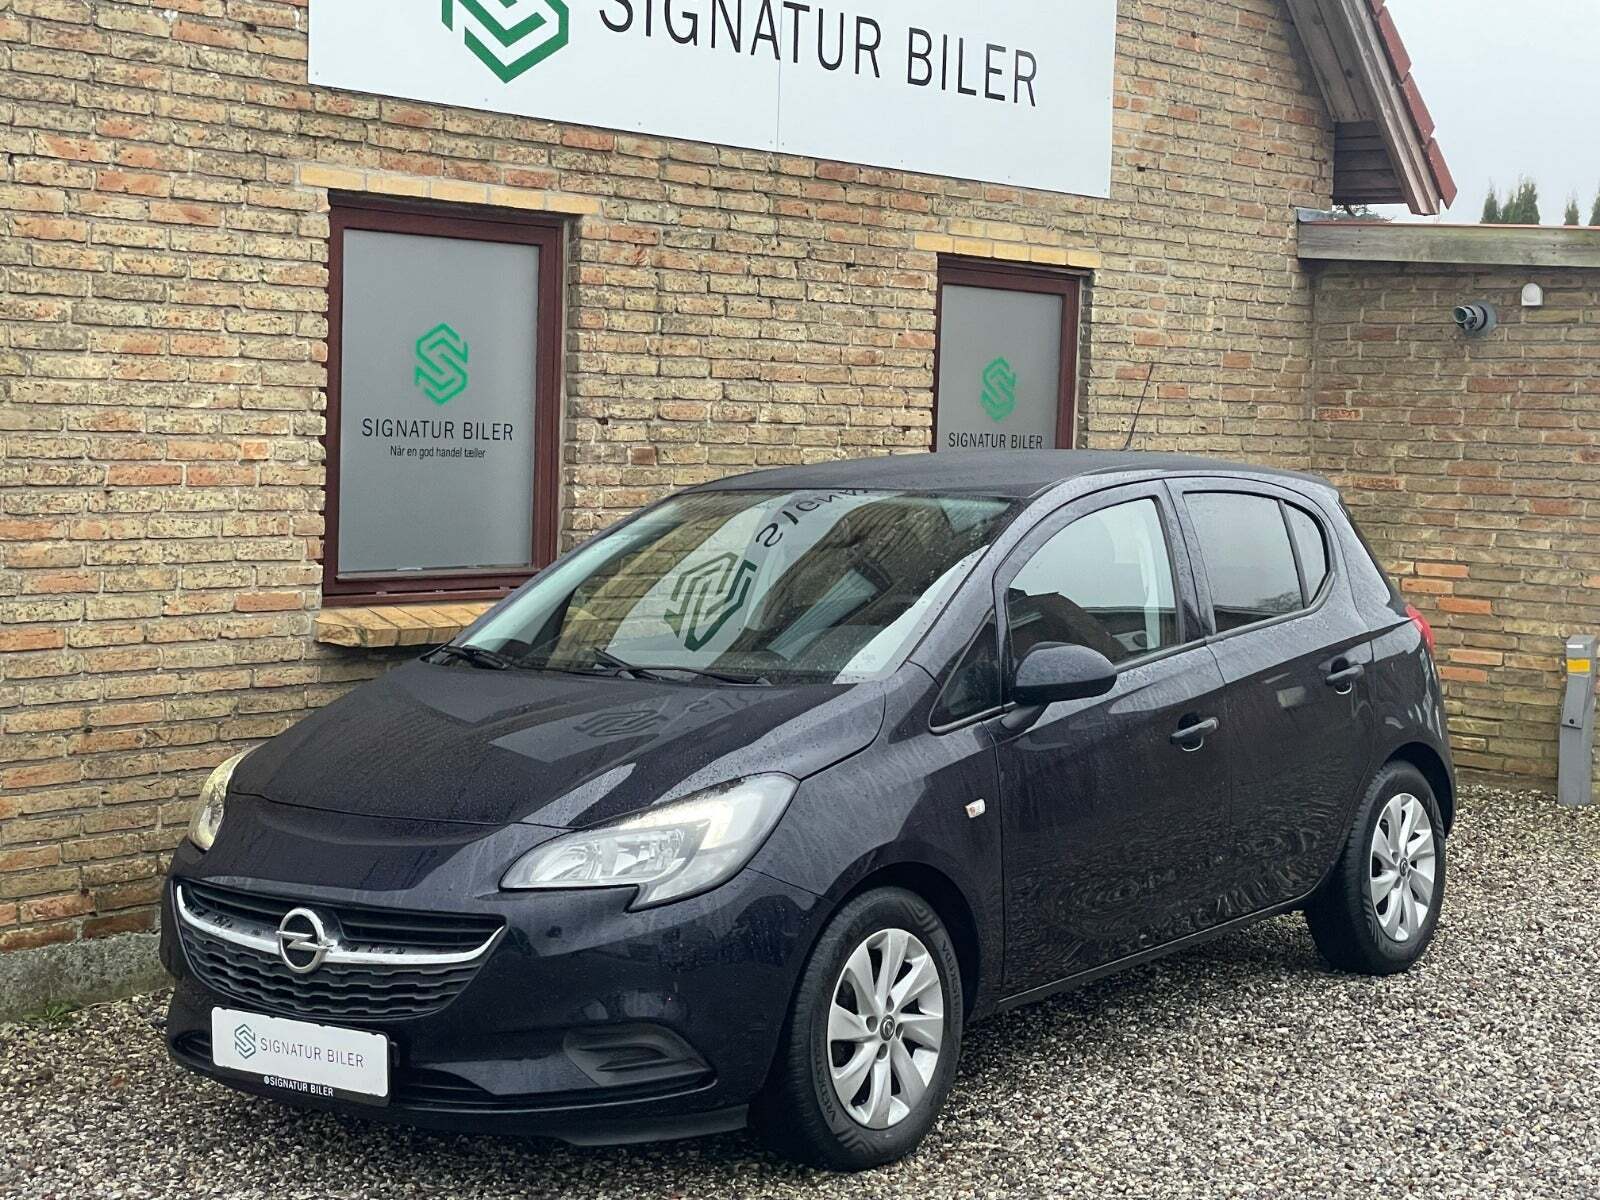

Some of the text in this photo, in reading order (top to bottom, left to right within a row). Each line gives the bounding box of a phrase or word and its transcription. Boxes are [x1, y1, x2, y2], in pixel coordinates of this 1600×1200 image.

[907, 26, 1036, 107] BILER
[361, 418, 513, 441] SIGNATUR BILER
[948, 432, 1043, 449] SIGNATUR BILER
[406, 447, 417, 457] en
[419, 446, 434, 460] god
[435, 446, 463, 458] handel
[260, 1037, 322, 1061] SIGNATUR
[327, 1049, 365, 1068] BILER
[269, 1076, 334, 1097] SIGNATUR BILER
